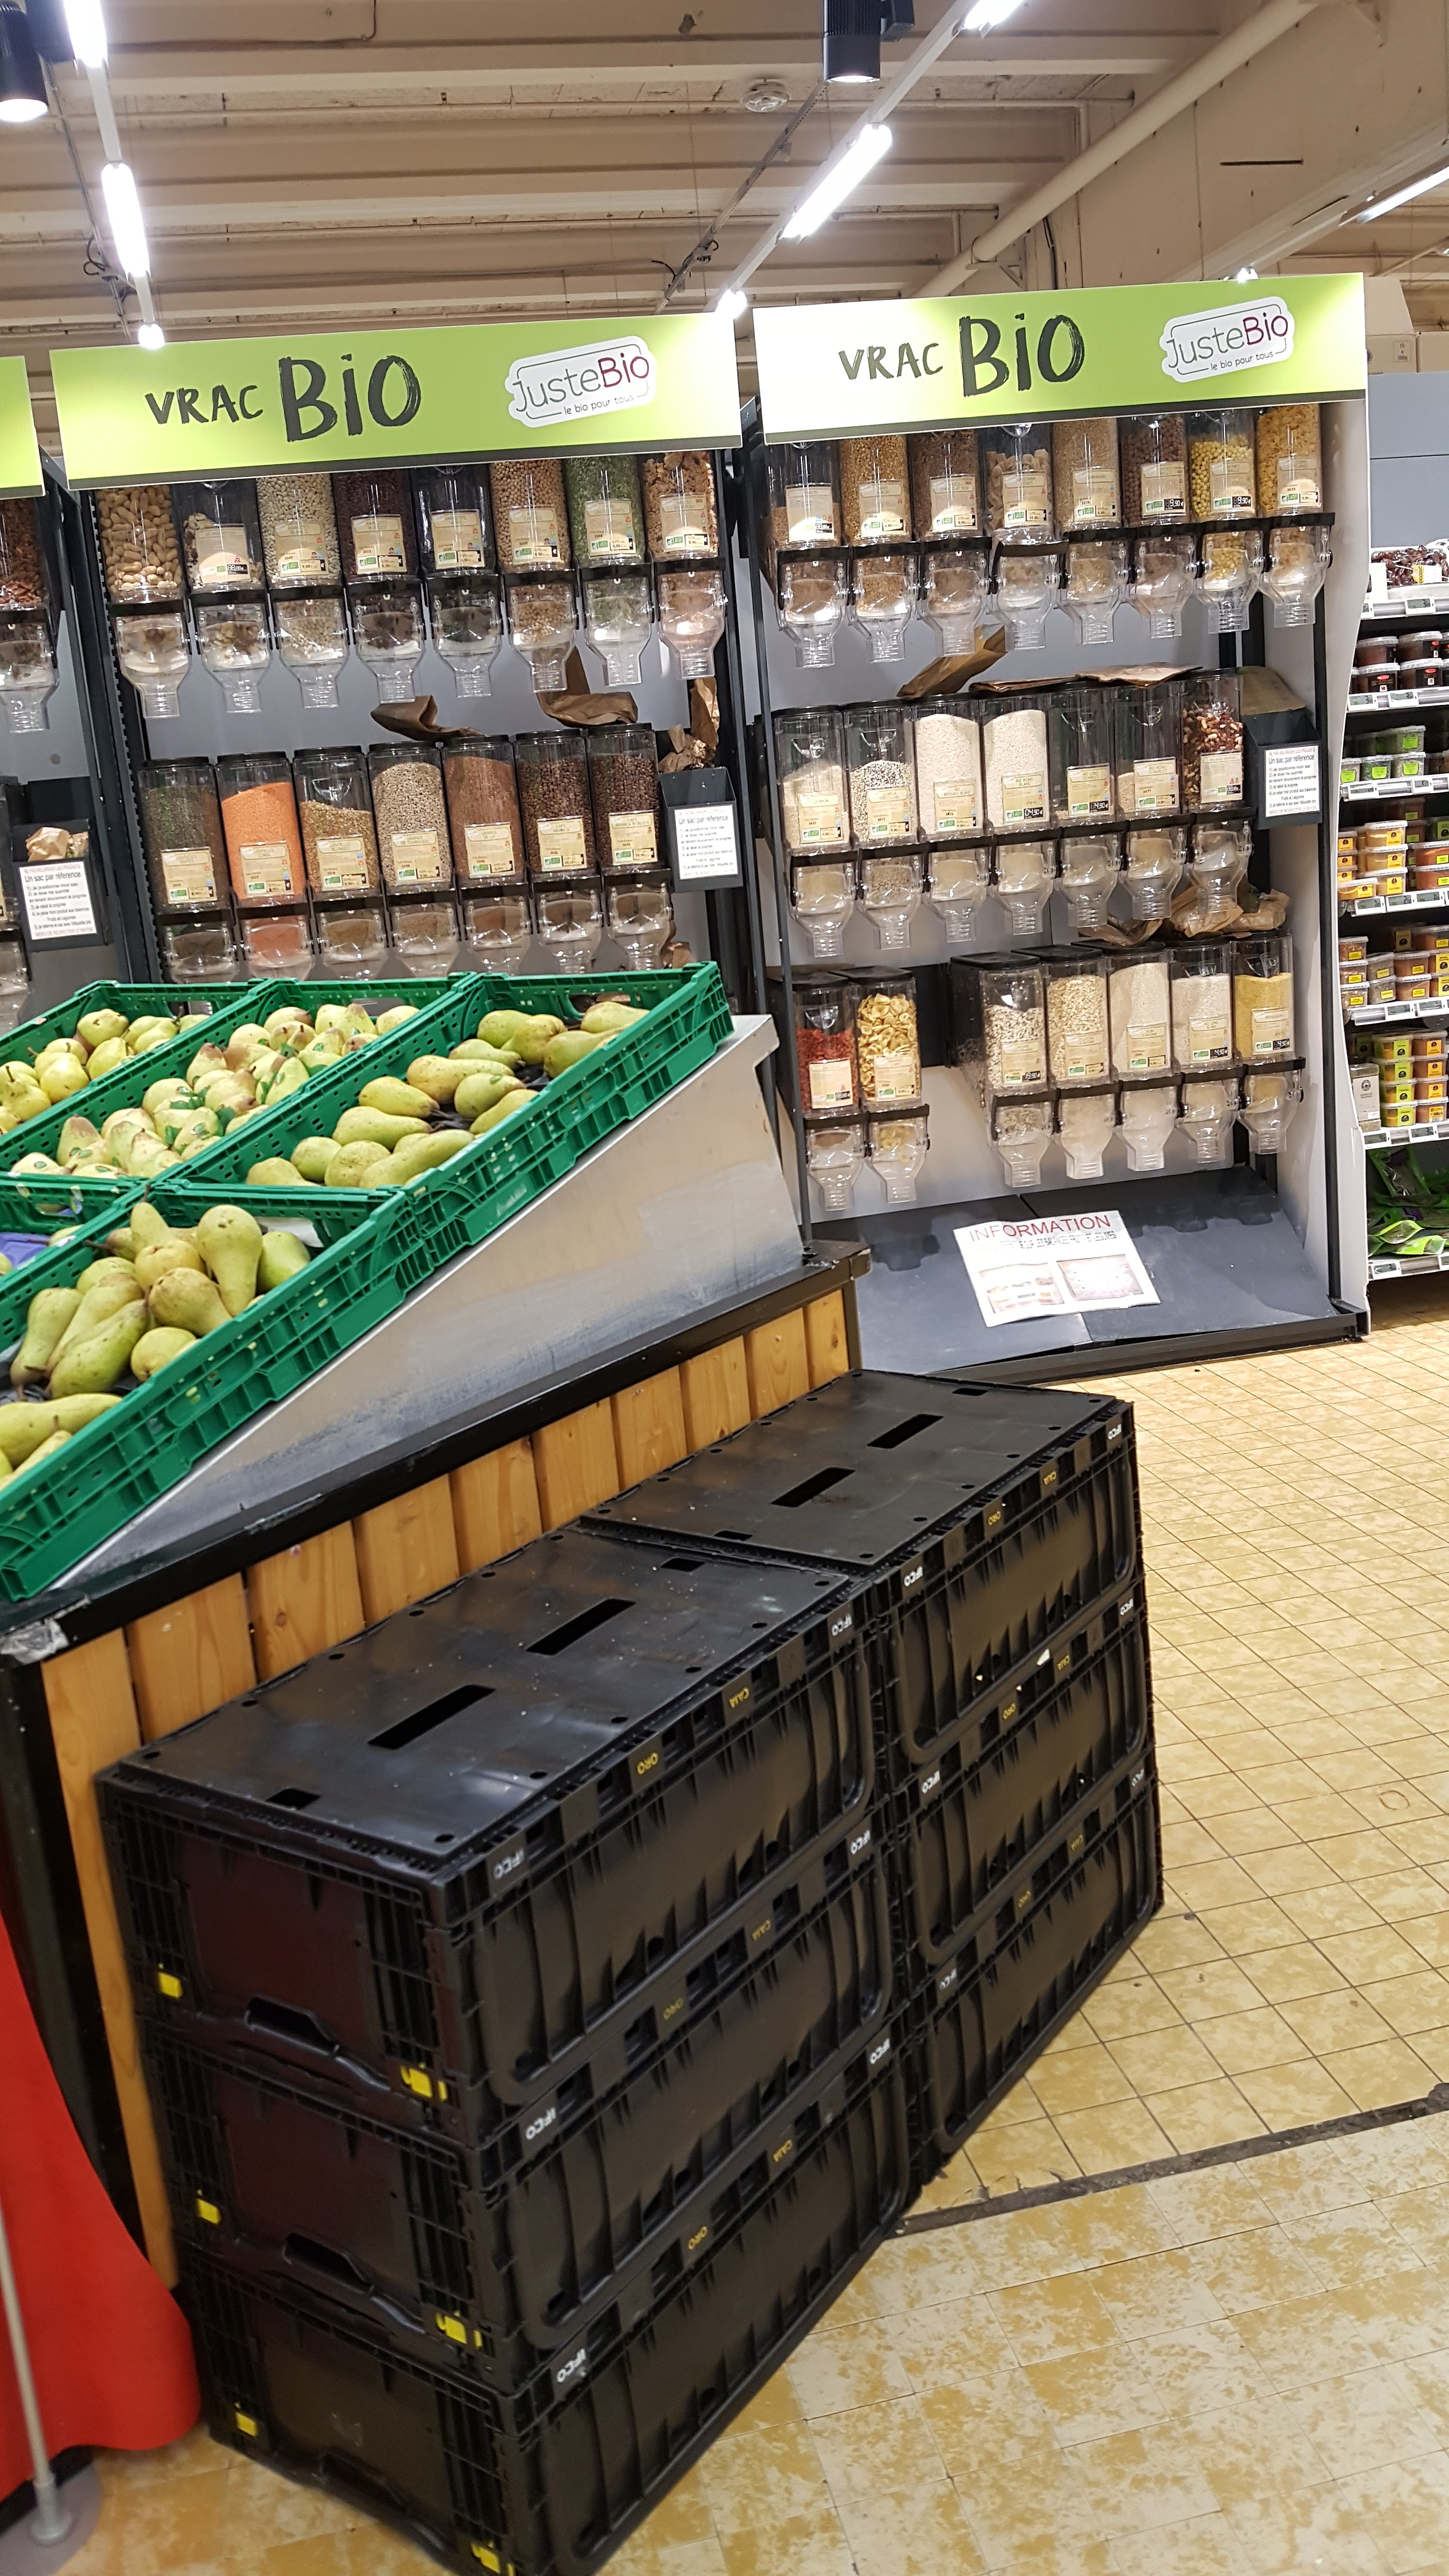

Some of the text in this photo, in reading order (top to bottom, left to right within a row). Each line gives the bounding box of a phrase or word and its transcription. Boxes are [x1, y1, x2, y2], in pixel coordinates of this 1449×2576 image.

[1166, 312, 1289, 369] JusteBio
[838, 343, 943, 380] VRAC
[1210, 350, 1274, 371] le bio pour tous
[512, 352, 650, 412] JusteBio
[145, 384, 264, 425] VRAC
[564, 393, 635, 416] le bio pour tous
[969, 1215, 1111, 1242] INFORMATION
[1108, 1424, 1122, 1440] IFCO
[904, 1566, 923, 1587] IFCO
[1120, 1598, 1134, 1615] IFCO
[831, 1614, 852, 1636] IFCO
[921, 1771, 940, 1794] IFCO
[850, 1830, 870, 1855] IFCO
[494, 1849, 524, 1879] IFCO
[869, 2038, 890, 2064] IFCO
[525, 2108, 556, 2140] IFCO
[557, 2349, 586, 2383] IFCO
